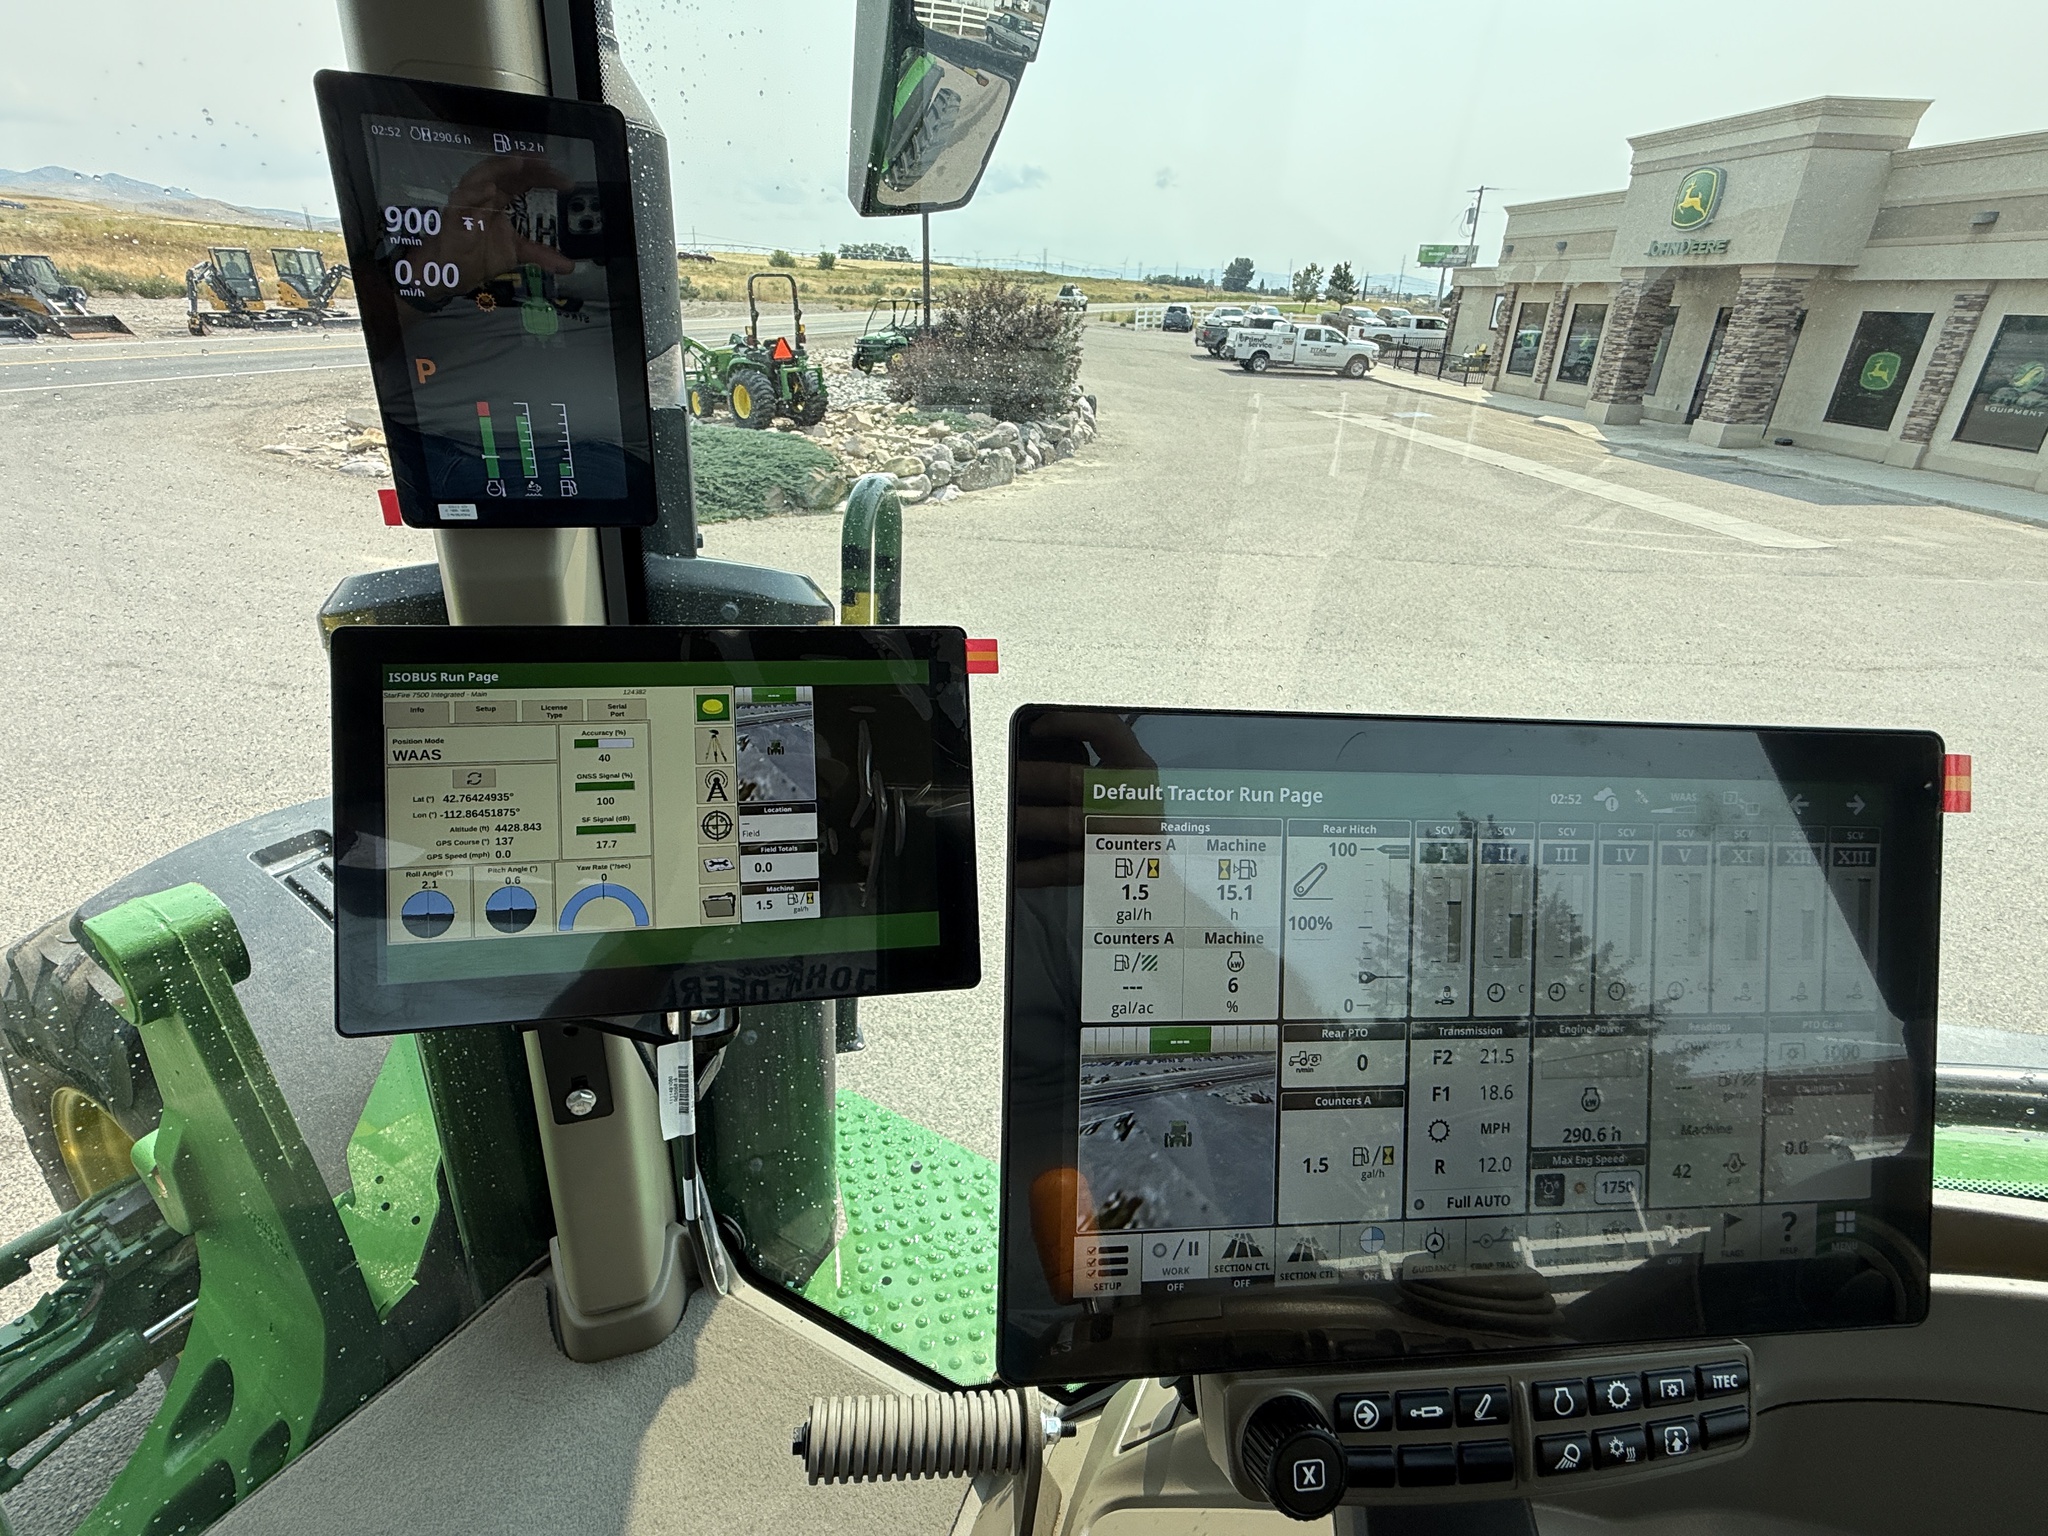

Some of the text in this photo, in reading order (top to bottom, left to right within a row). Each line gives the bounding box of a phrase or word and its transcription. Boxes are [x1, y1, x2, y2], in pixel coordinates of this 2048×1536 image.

[371, 125, 401, 138] 02:52
[432, 130, 461, 144] 290.6
[513, 141, 535, 152] 15.2
[384, 205, 442, 235] 900
[390, 235, 422, 247] n/min
[395, 259, 459, 288] 0.00
[400, 287, 425, 298] mi/h
[415, 358, 436, 384] P
[1984, 405, 2045, 418] EQUIPMENT
[388, 671, 499, 685] ISOBUS Run Page
[383, 691, 410, 699] StarFire
[412, 691, 430, 699] 7500
[430, 691, 466, 699] Integrated
[475, 706, 496, 714] Setup
[581, 730, 612, 738] Accuracy
[392, 737, 445, 746] Position Mode
[392, 749, 442, 762] WAAS
[598, 754, 611, 763] 40
[598, 772, 620, 781] Signal
[596, 797, 615, 806] 100
[1093, 784, 1323, 807] Default Tractor Run Page
[1550, 794, 1582, 805] 02:52
[1671, 792, 1697, 801] WAAS
[593, 815, 614, 823] Signal
[450, 823, 542, 833] Altitude (ft) 4428.843
[742, 830, 760, 838] Field
[1160, 822, 1210, 834] Readings
[1323, 824, 1377, 834] Rear Hitch
[1435, 826, 1454, 835] SCV
[1497, 827, 1516, 836] SCV
[1558, 827, 1577, 836] SCV
[1617, 828, 1636, 837] SCV
[1676, 829, 1694, 838] SCV
[495, 837, 514, 846] 137
[596, 840, 617, 849] 17.7
[1095, 838, 1176, 851] Counters A
[1206, 839, 1266, 852] Machine
[427, 850, 511, 861] GPS Speed (mph) 0.0
[1328, 842, 1358, 857] 100
[1498, 847, 1513, 862] II
[1555, 847, 1578, 862] III
[1616, 848, 1636, 862] IV
[1678, 849, 1691, 863] V
[1838, 851, 1870, 864] XIII
[487, 866, 528, 875] Pitch Angle
[576, 863, 590, 871] Yaw
[754, 862, 773, 873] 0.0
[422, 870, 443, 878] Angle
[421, 880, 438, 890] 2.1
[505, 876, 521, 885] 0.6
[1121, 884, 1149, 900] 1.5
[1216, 884, 1252, 900] 15.1
[756, 900, 773, 910] 1.5
[793, 906, 809, 914] gal/h
[1116, 908, 1152, 922] gal/h
[1230, 908, 1238, 921] h
[1288, 915, 1333, 931] 100%
[1093, 932, 1174, 945] Counters A
[1204, 931, 1264, 945] Machine
[1228, 977, 1238, 993] 6
[1111, 1001, 1154, 1016] gal/ac
[1226, 1001, 1239, 1013] %
[1344, 999, 1353, 1013] 0
[1559, 1025, 1593, 1036] Engine
[1802, 1020, 1820, 1029] PTO
[1322, 1027, 1368, 1038] Rear PTO
[1438, 1026, 1503, 1036] Transmission
[1433, 1050, 1453, 1065] F2
[1480, 1048, 1514, 1064] 21.5
[1357, 1054, 1368, 1072] 0
[1295, 1066, 1314, 1074] n/min
[1432, 1086, 1450, 1102] F1
[1480, 1085, 1513, 1100] 18.6
[1315, 1095, 1372, 1107] Counters A
[1480, 1122, 1510, 1135] MPH
[1681, 1124, 1733, 1135] Machine
[1562, 1128, 1606, 1143] 290.6
[1303, 1157, 1329, 1174] 1.5
[1435, 1159, 1446, 1174] R
[1478, 1156, 1512, 1172] 12.0
[1552, 1155, 1625, 1166] Max Eng Speed
[1361, 1169, 1385, 1182] gal/h
[1672, 1164, 1692, 1179] 42
[1602, 1181, 1634, 1194] 1750
[1447, 1195, 1511, 1208] Full AUTO
[1779, 1246, 1798, 1255] HELP
[1831, 1241, 1858, 1253] MENU
[1721, 1249, 1745, 1259] FLAGS
[1161, 1266, 1190, 1276] WORK
[1214, 1262, 1270, 1274] SECTION CTL
[1411, 1264, 1457, 1274] GUIDANCE
[1280, 1269, 1334, 1282] SECTION CTL
[1093, 1281, 1122, 1292] SETUP
[1167, 1283, 1184, 1292] OFF
[1233, 1279, 1250, 1288] OFF
[1713, 1374, 1738, 1390] iTEC
[1302, 1466, 1317, 1486] X
